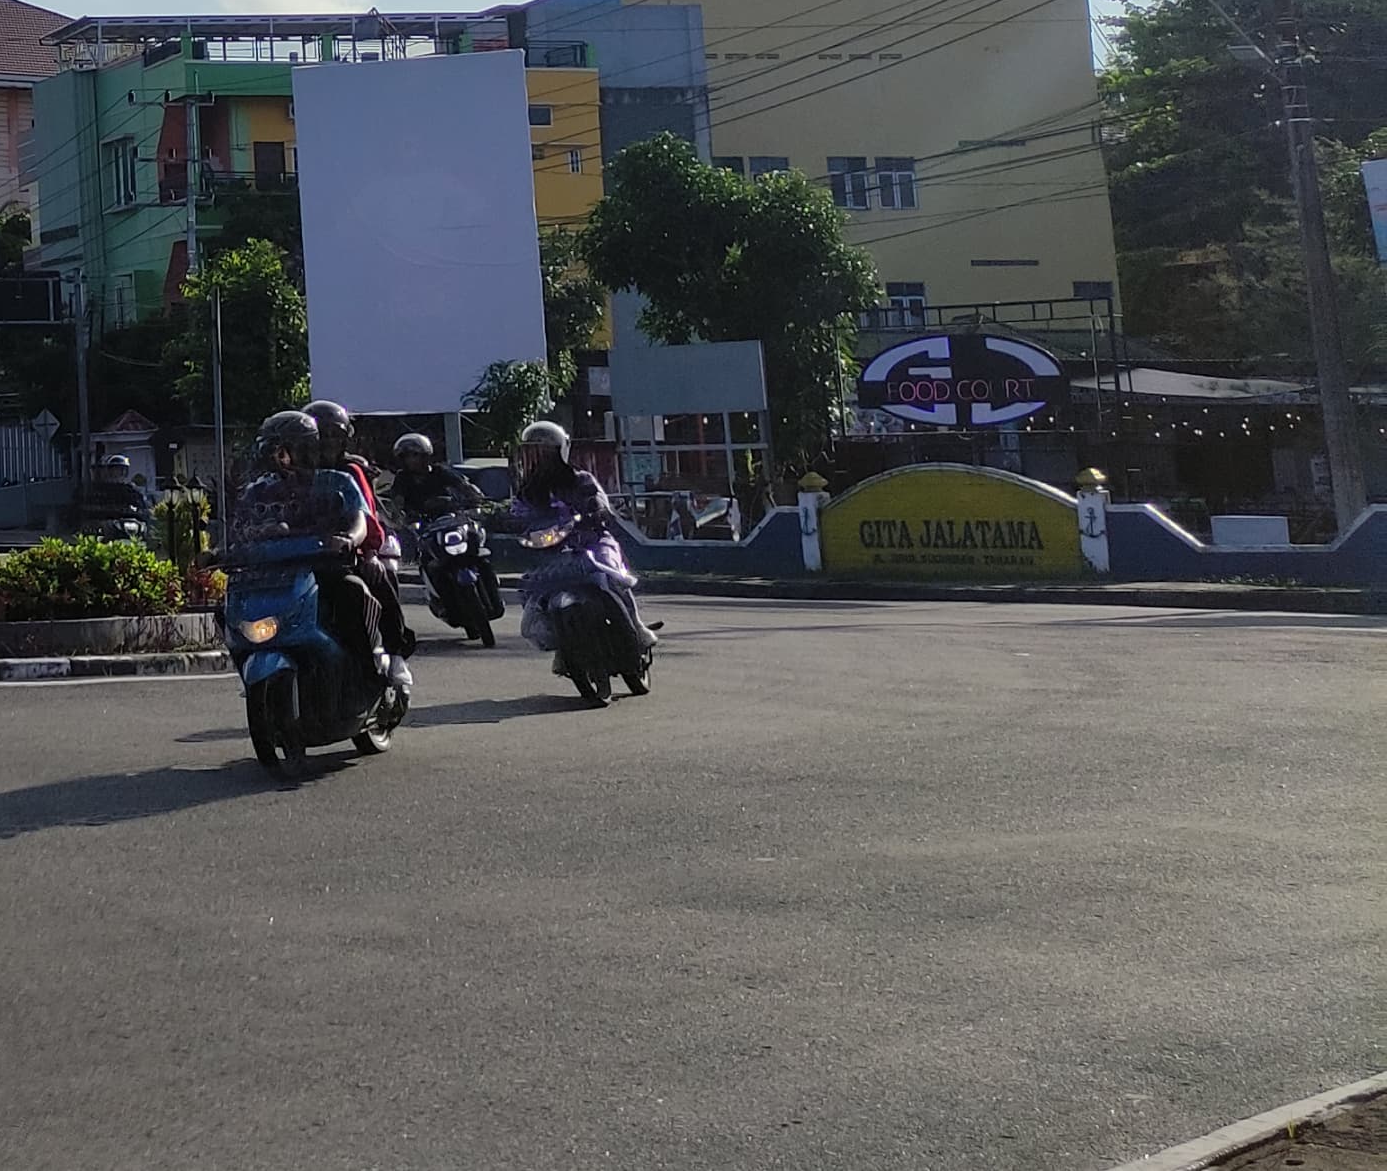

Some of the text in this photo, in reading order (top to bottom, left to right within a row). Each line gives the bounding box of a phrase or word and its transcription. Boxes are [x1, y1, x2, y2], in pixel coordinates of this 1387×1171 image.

[887, 379, 1034, 402] FOOD CORT
[859, 520, 1044, 550] GITA JALATAMA
